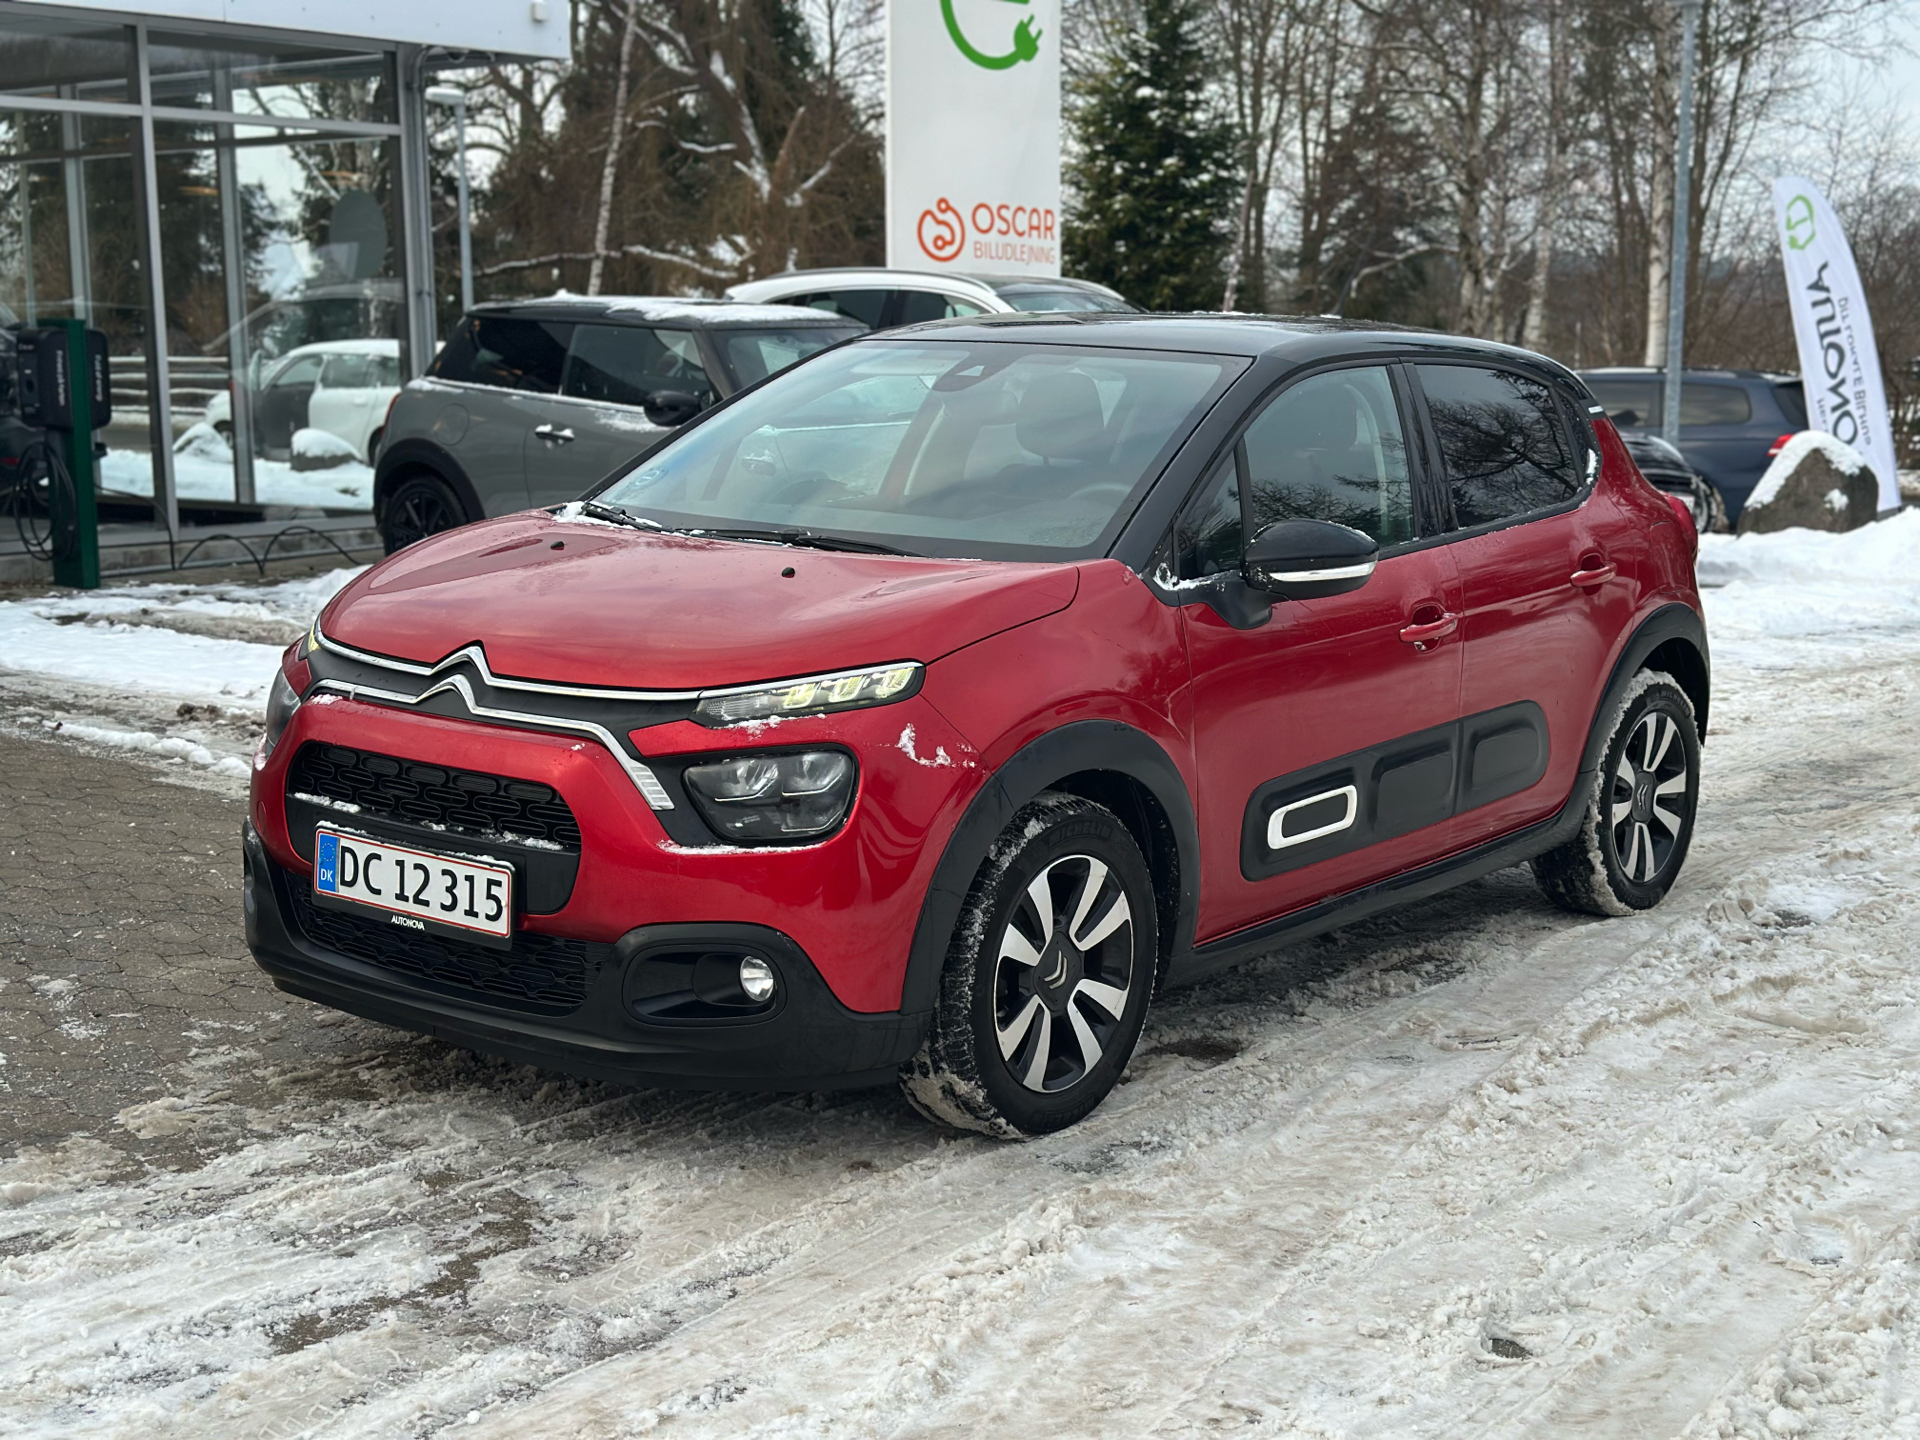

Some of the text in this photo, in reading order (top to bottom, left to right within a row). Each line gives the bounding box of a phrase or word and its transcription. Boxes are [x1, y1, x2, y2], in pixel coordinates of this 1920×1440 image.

[972, 202, 1055, 241] OSCAR
[973, 240, 1056, 266] BILUDLEJNING
[320, 868, 333, 883] DK
[340, 845, 504, 922] DC 12 315
[390, 914, 426, 931] AUTONOVA
